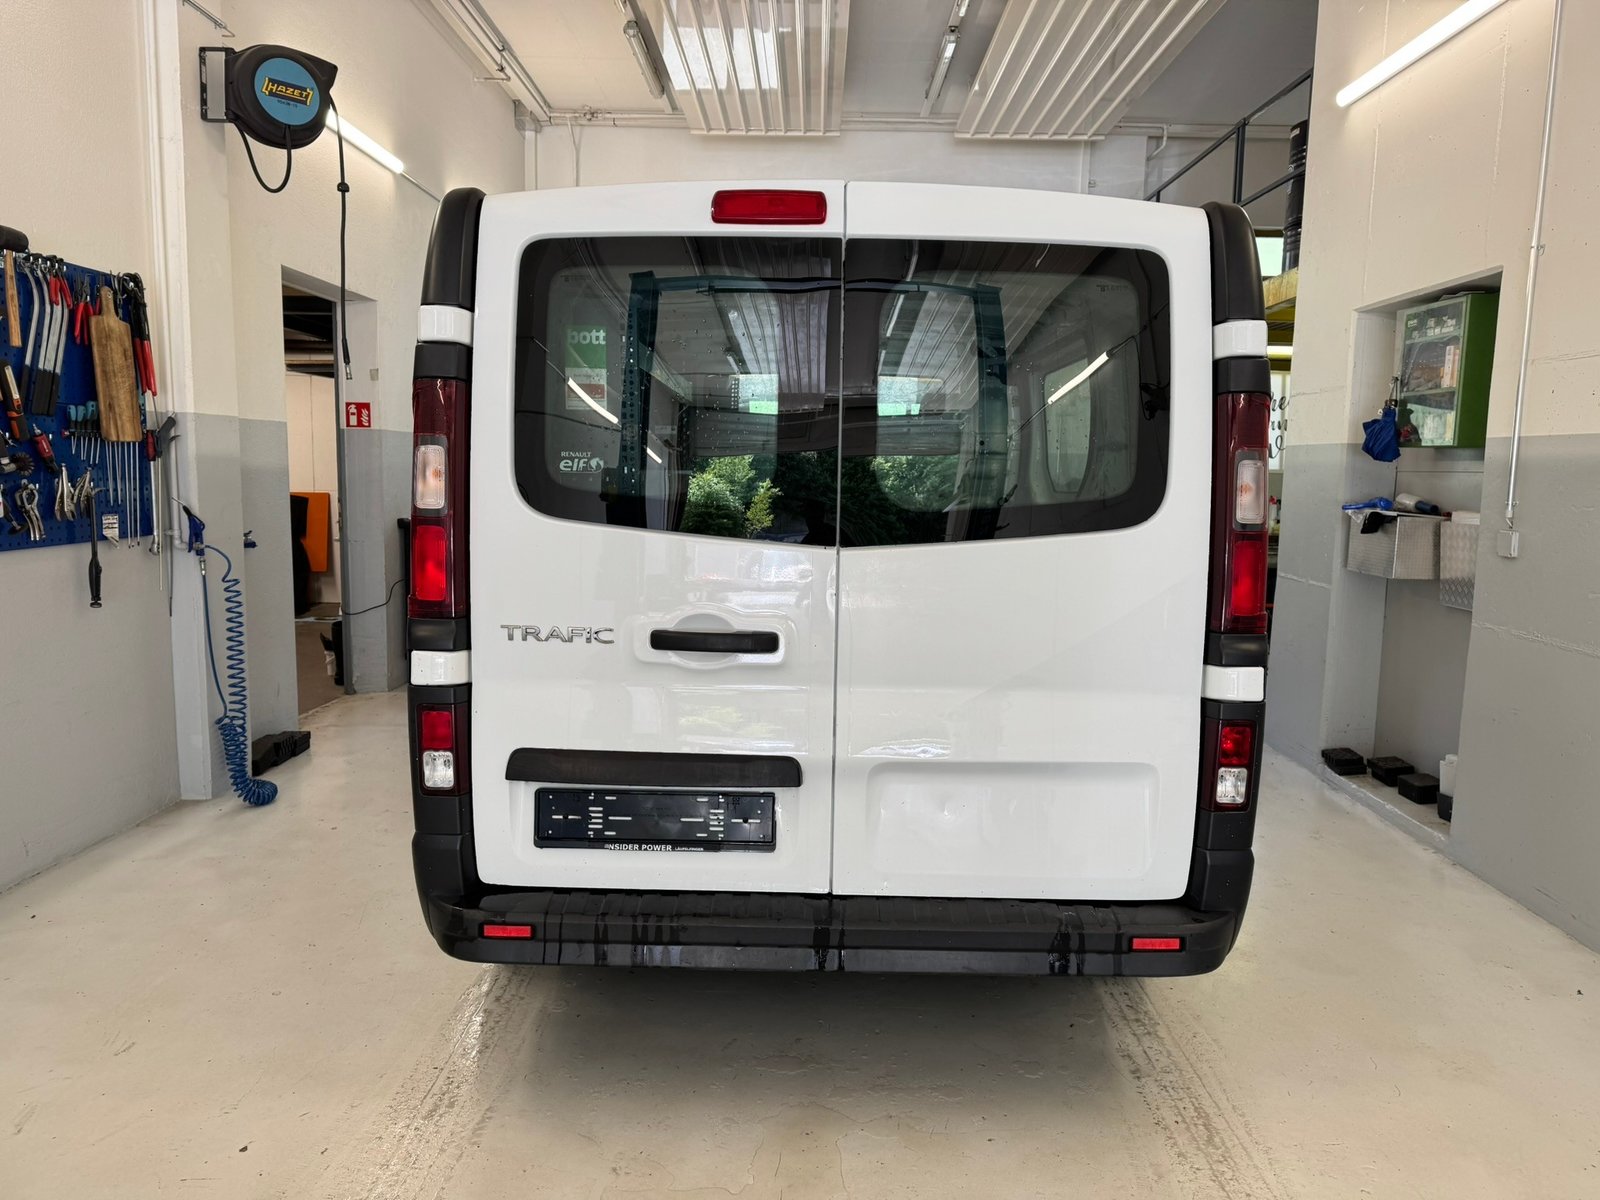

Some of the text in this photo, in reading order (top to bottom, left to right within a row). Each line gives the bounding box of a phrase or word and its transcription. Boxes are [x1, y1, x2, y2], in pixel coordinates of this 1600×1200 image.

[267, 82, 308, 98] HAZET
[568, 328, 606, 345] bott
[559, 458, 588, 472] elf
[500, 624, 615, 644] TRAFIC
[604, 843, 640, 851] NSIDER
